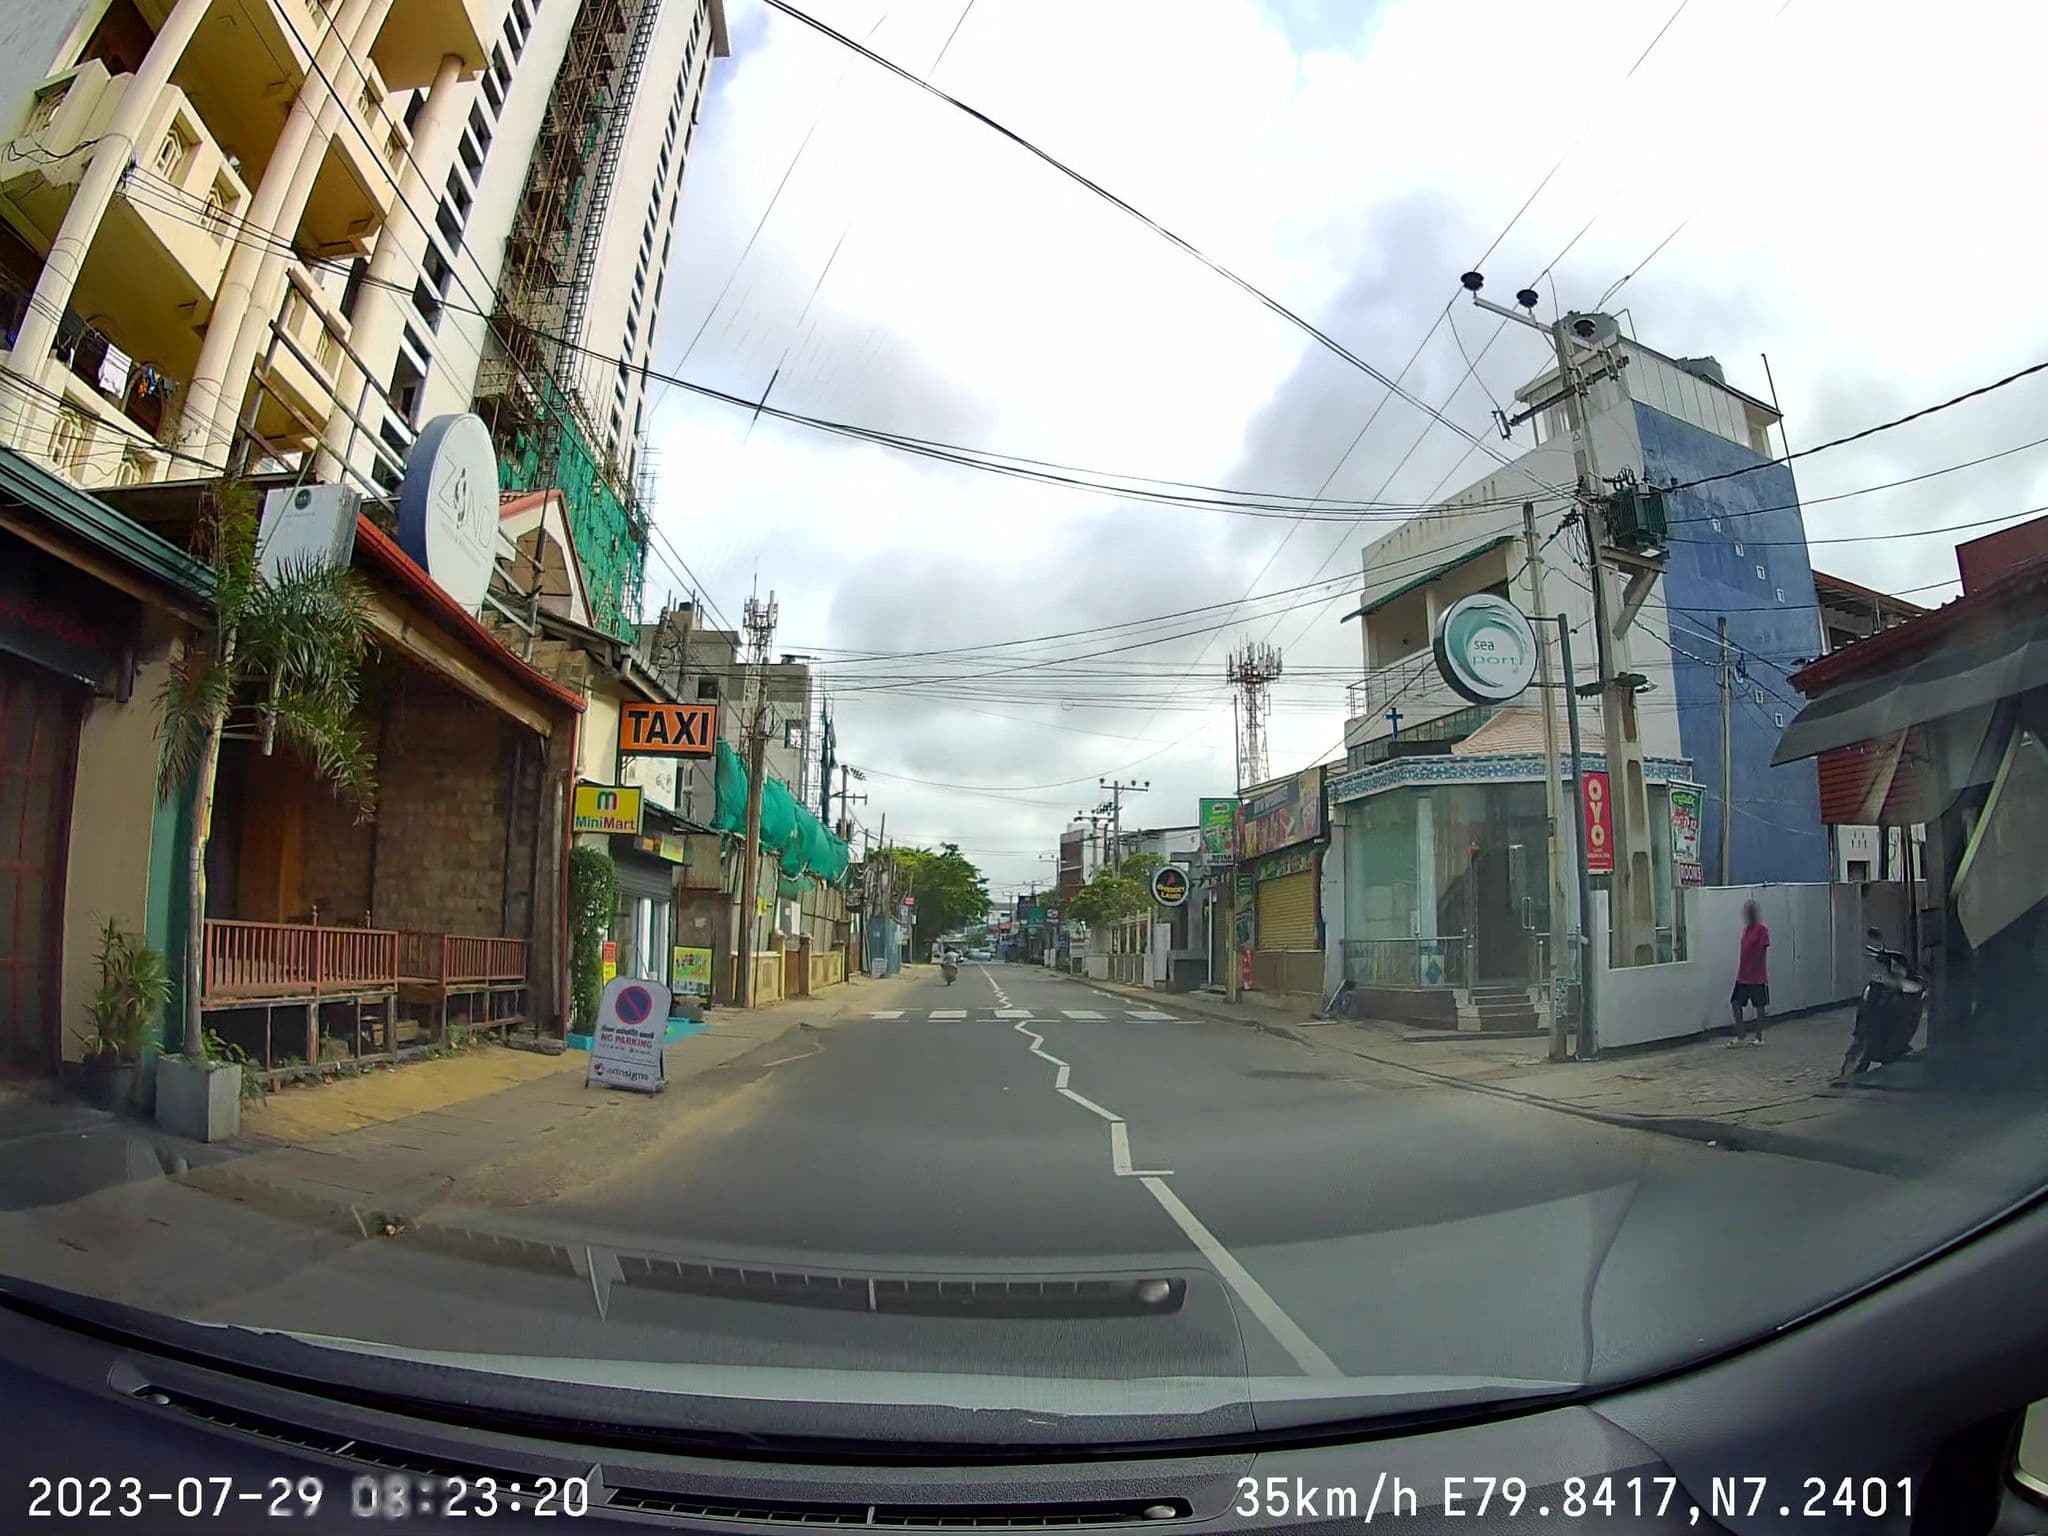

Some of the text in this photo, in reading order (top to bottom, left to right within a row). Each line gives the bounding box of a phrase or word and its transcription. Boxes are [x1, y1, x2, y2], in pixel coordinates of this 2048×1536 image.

[1473, 640, 1495, 651] sea
[1472, 655, 1517, 666] port
[628, 710, 709, 746] TAXI
[1588, 778, 1605, 847] OYO
[575, 815, 636, 831] MiniMart
[601, 1033, 613, 1042] NO
[615, 1035, 652, 1049] PARKING
